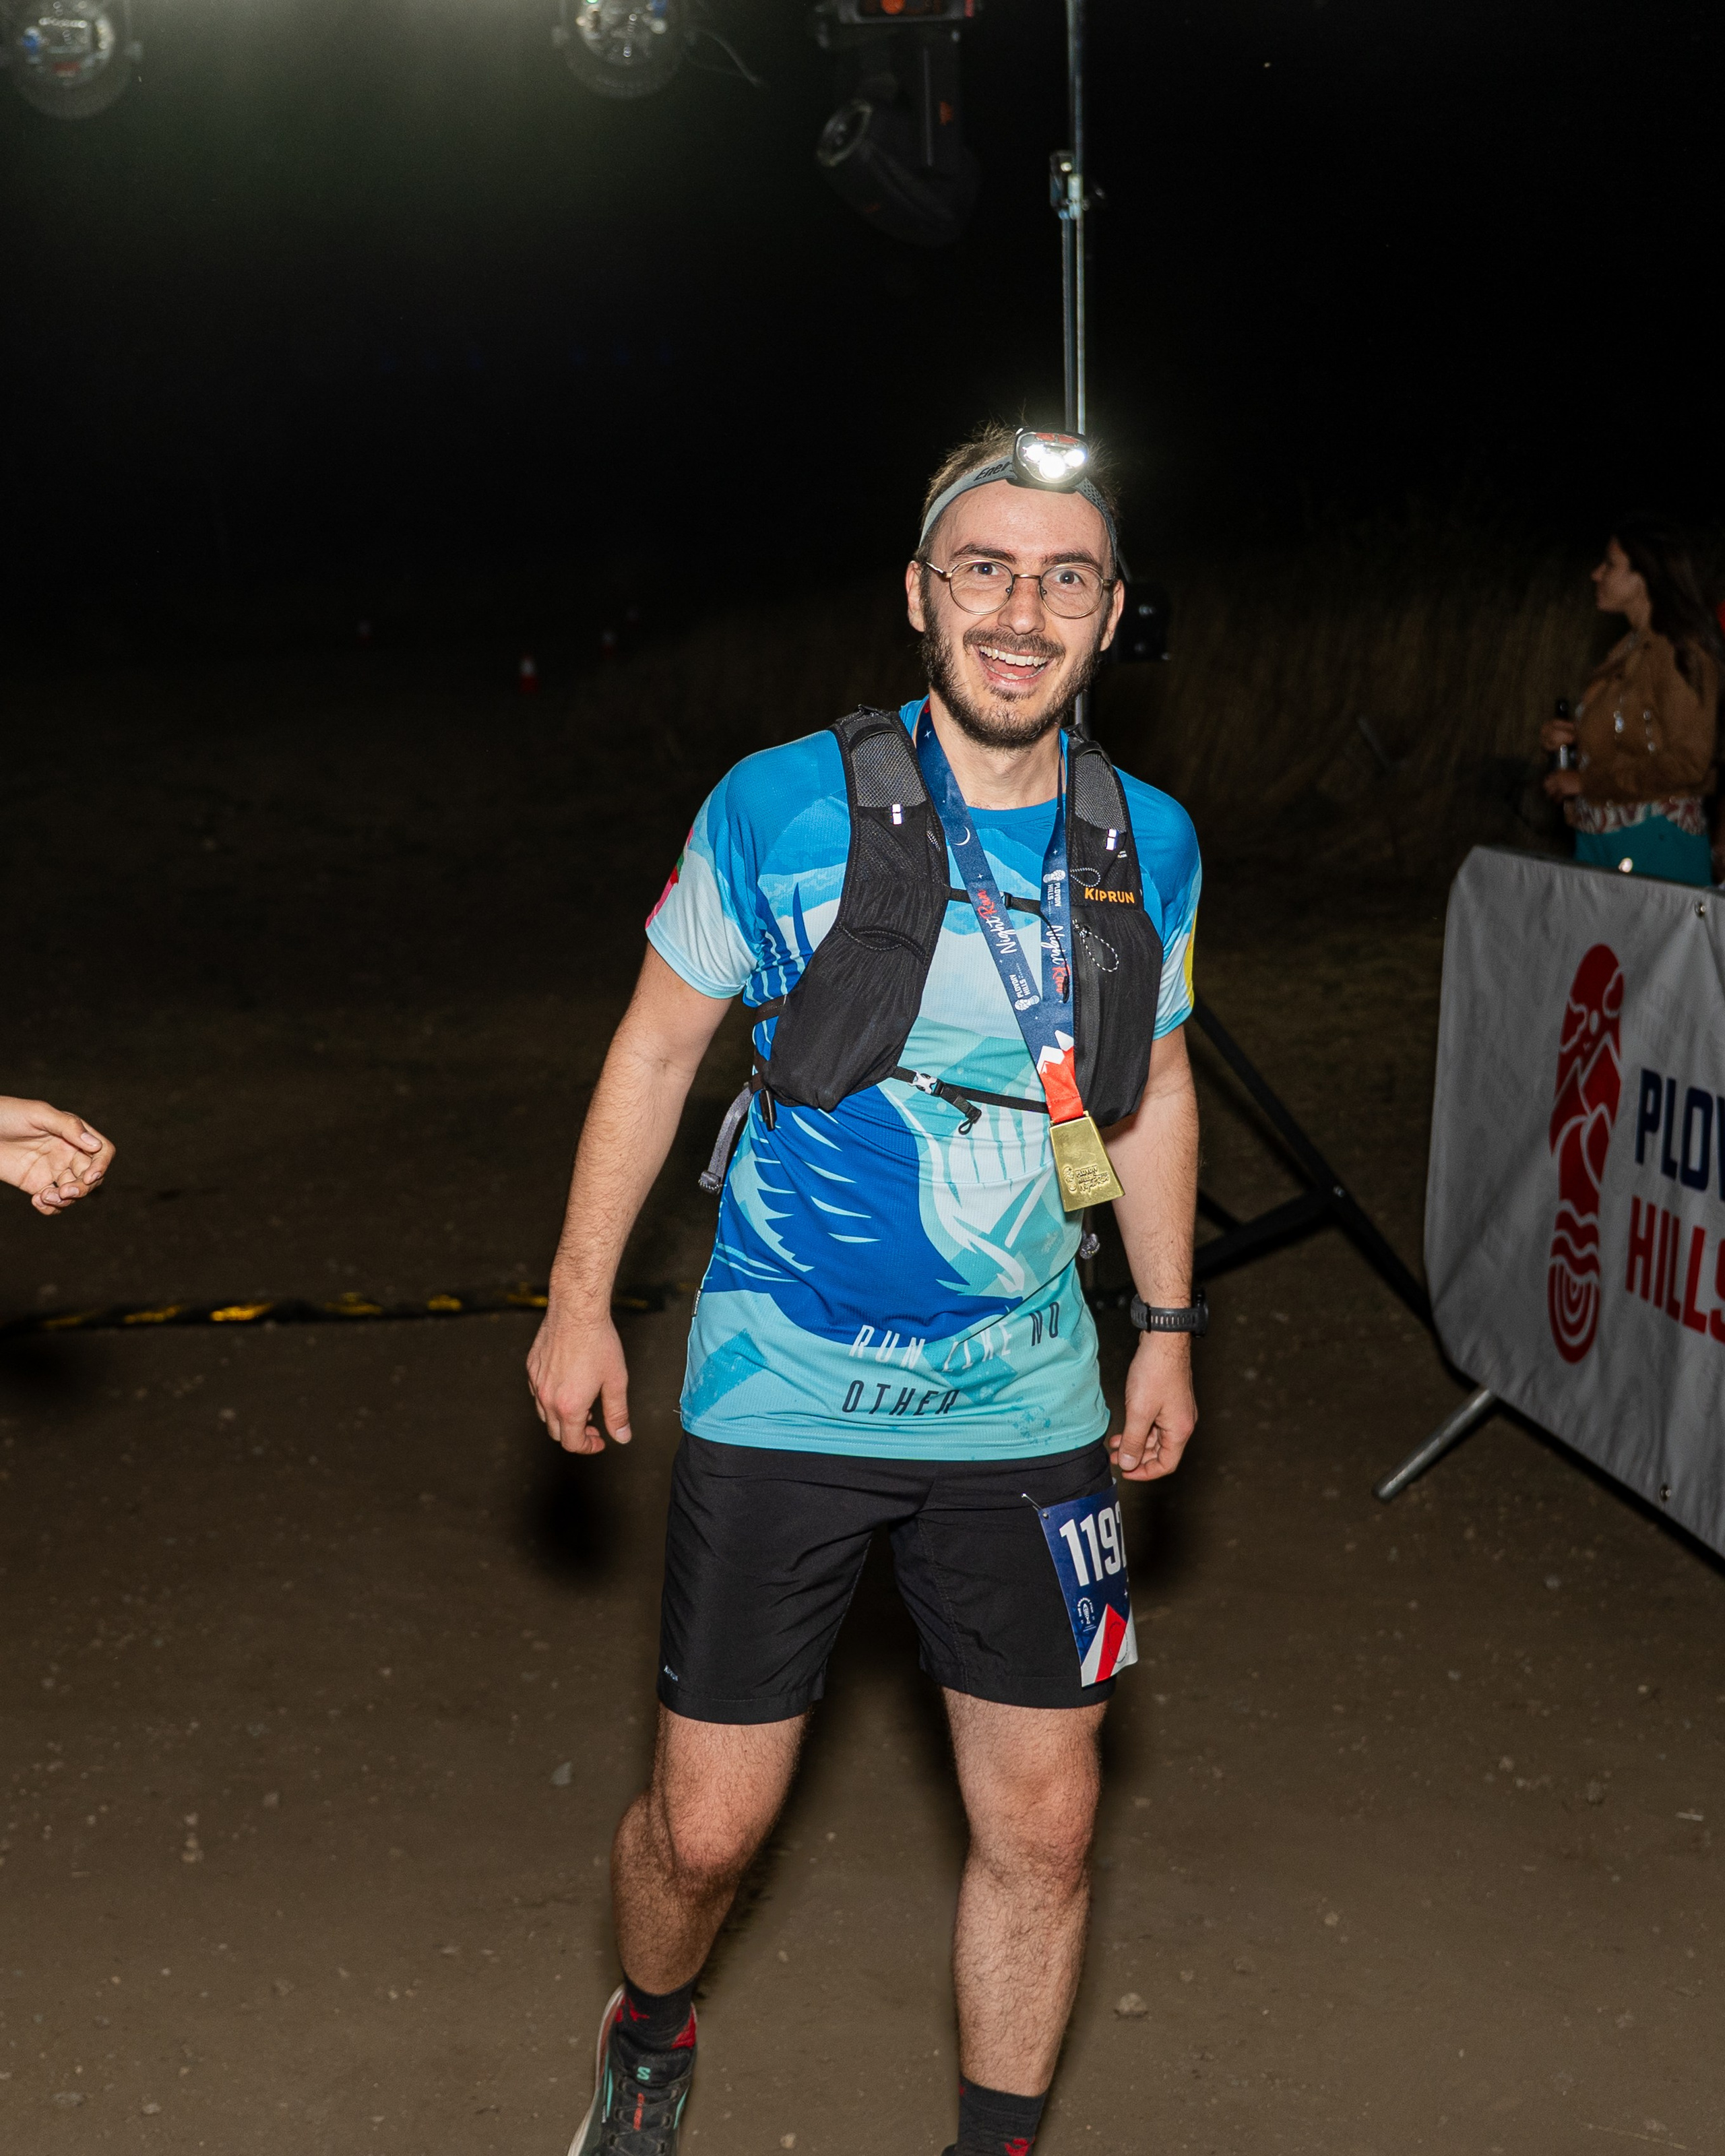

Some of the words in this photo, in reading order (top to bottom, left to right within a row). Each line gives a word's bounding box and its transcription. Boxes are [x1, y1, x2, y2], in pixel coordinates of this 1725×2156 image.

[974, 461, 1013, 480] Ener
[977, 889, 997, 920] Run
[1084, 887, 1135, 903] KIPRUN
[986, 916, 1017, 955] Night
[1019, 978, 1031, 996] HILLS
[1635, 1068, 1725, 1203] PLO
[849, 1325, 925, 1370] RUN
[942, 1321, 1012, 1372] LIKE
[1029, 1302, 1059, 1346] NO
[842, 1380, 960, 1416] OTHER
